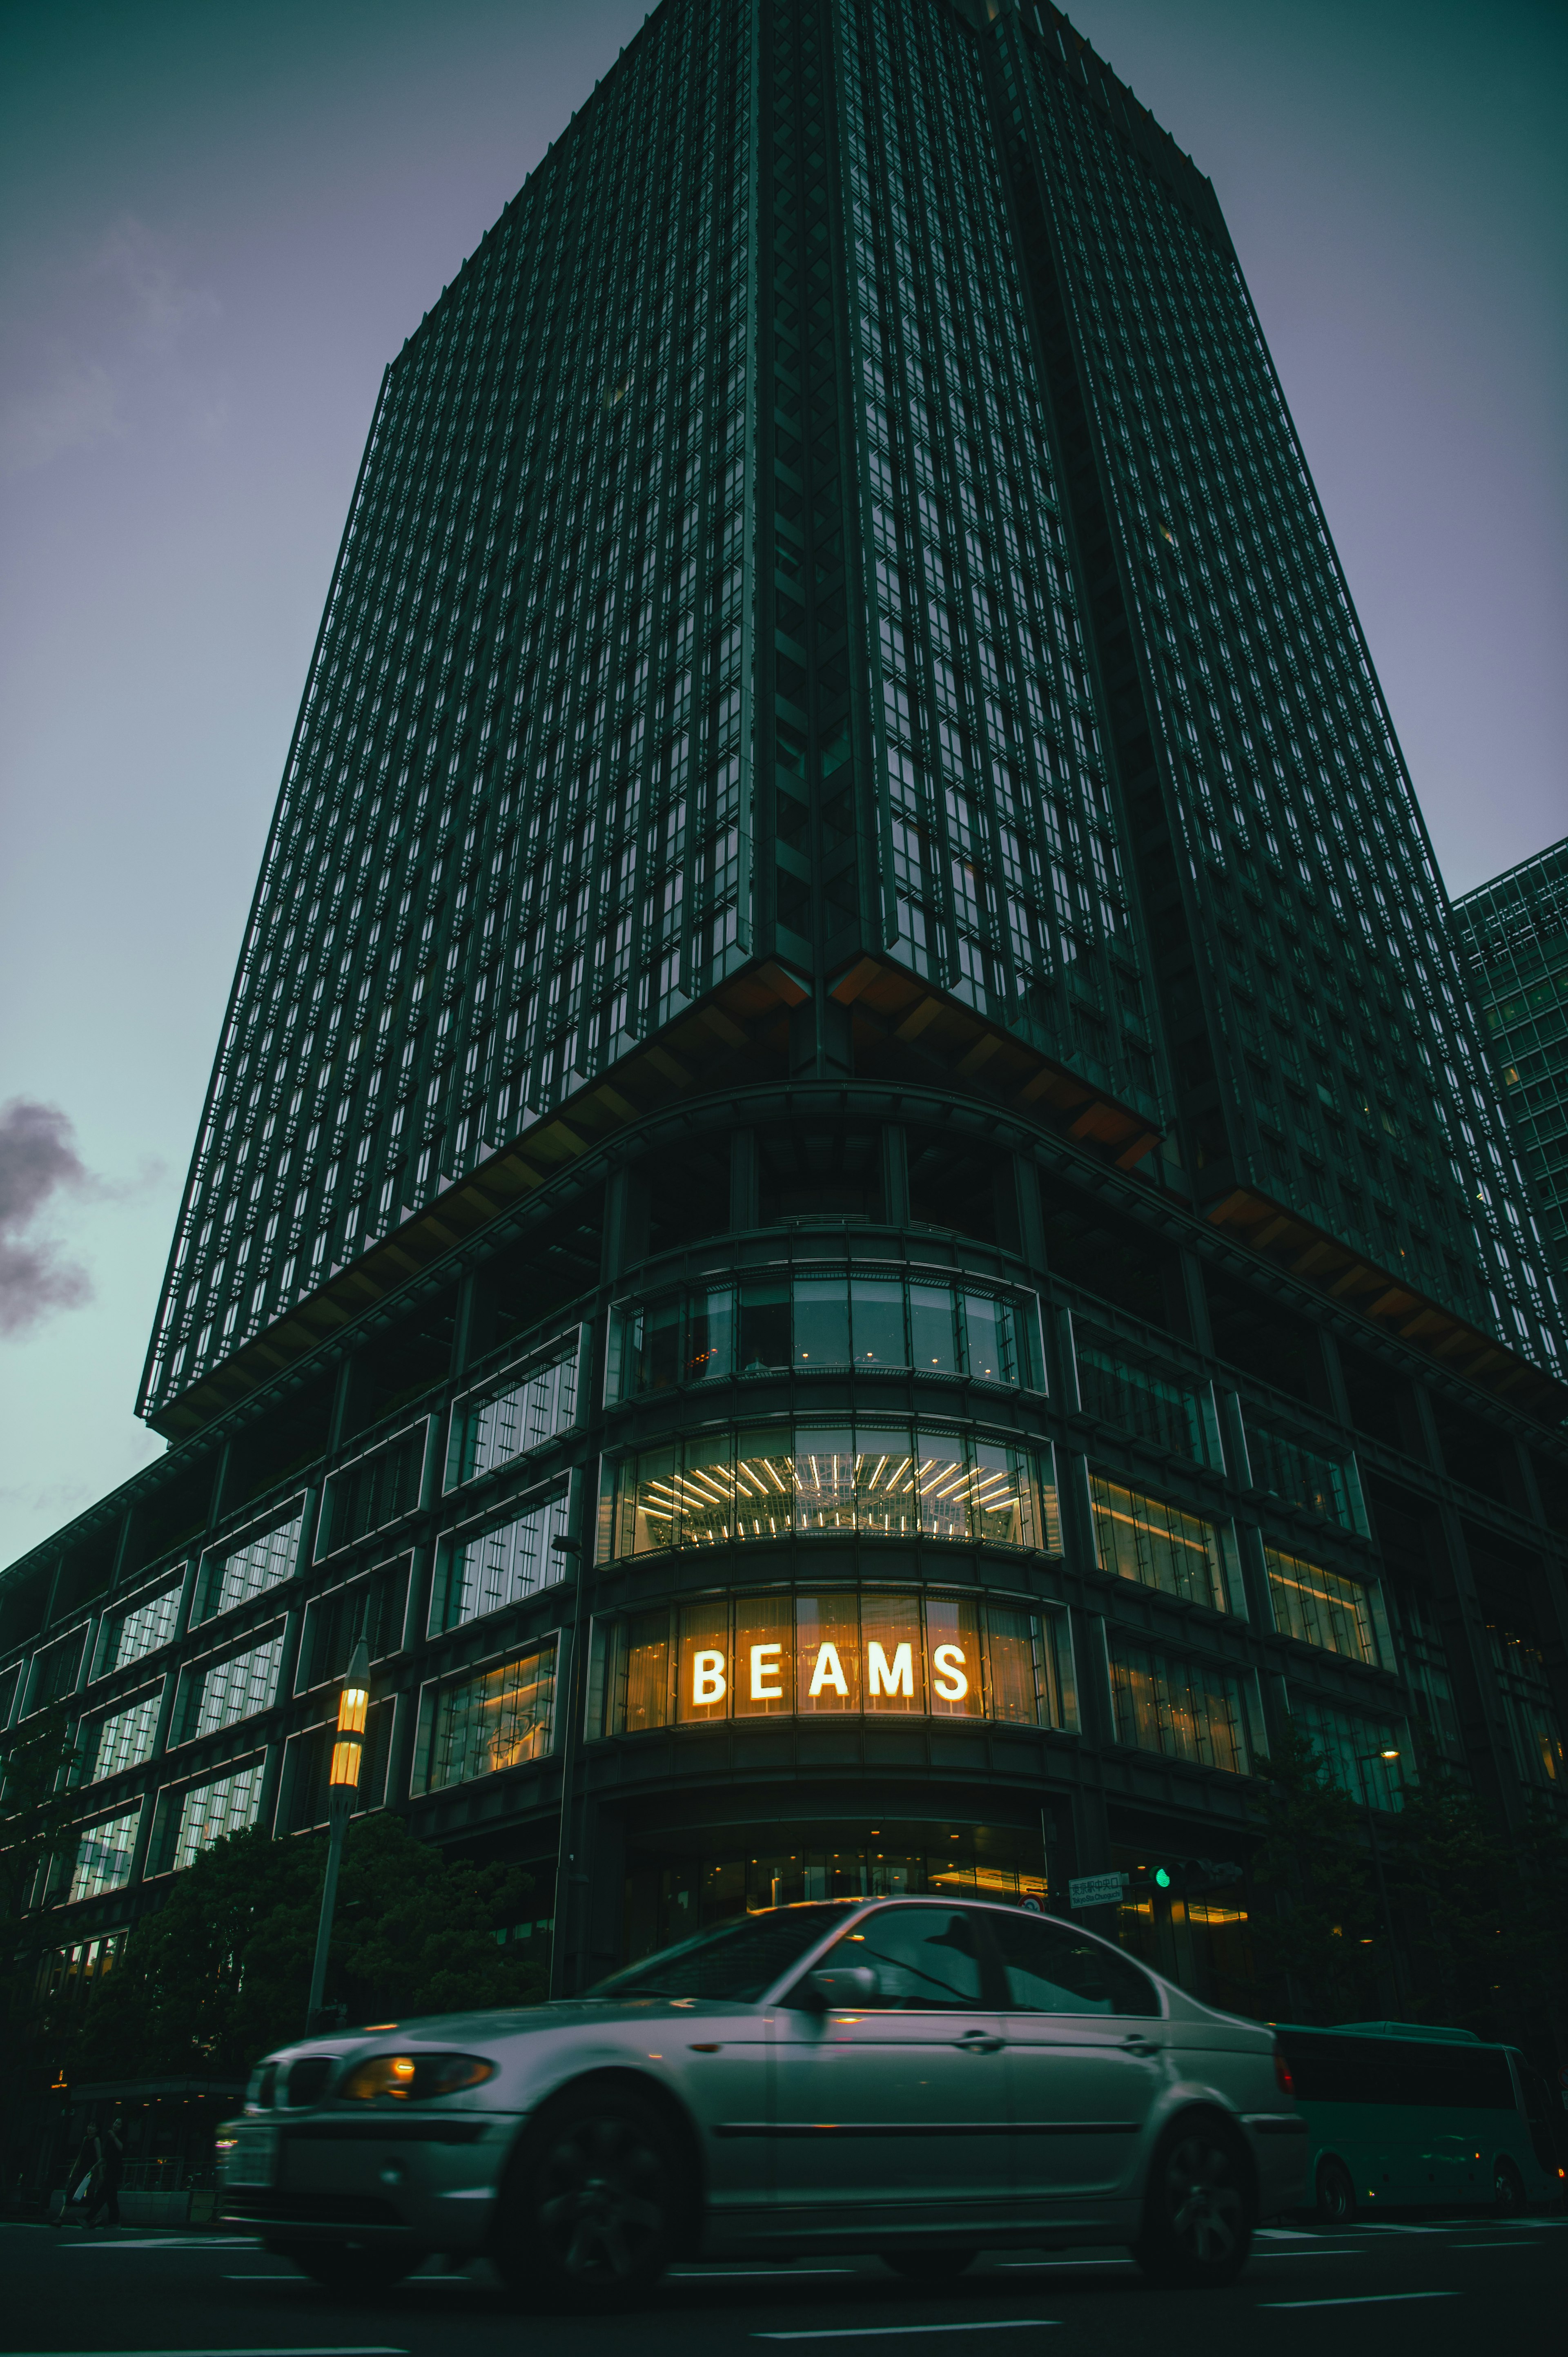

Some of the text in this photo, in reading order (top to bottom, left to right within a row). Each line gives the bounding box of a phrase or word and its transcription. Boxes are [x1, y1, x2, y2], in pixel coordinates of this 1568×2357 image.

[693, 1641, 968, 1706] BEAMS
[1072, 1878, 1118, 1895] 東京駅中央口
[1095, 1890, 1120, 1900] Chuoguchi
